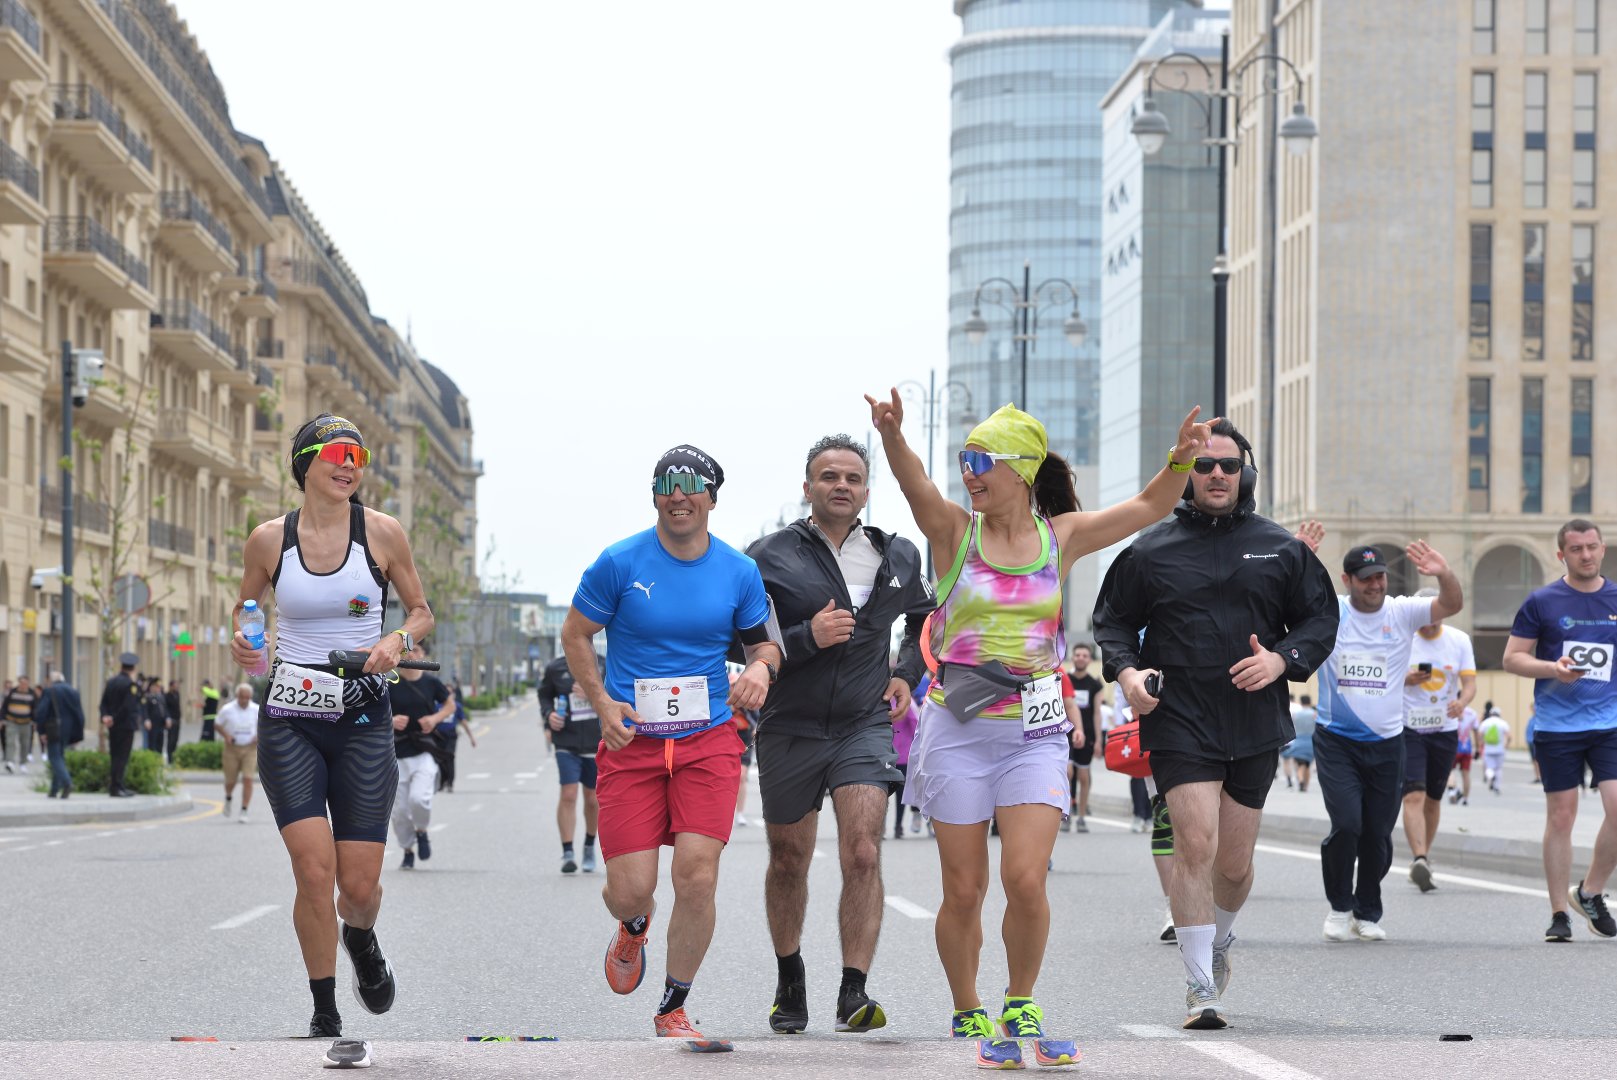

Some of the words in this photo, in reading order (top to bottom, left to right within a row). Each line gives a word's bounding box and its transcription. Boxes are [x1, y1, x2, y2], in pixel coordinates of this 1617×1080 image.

[1569, 645, 1608, 669] GO
[1342, 665, 1383, 678] 14570
[272, 684, 337, 708] 23225
[667, 699, 680, 716] 5
[1028, 699, 1064, 725] 220
[641, 723, 669, 732] KÜLƏYƏ
[1411, 716, 1442, 726] 21540
